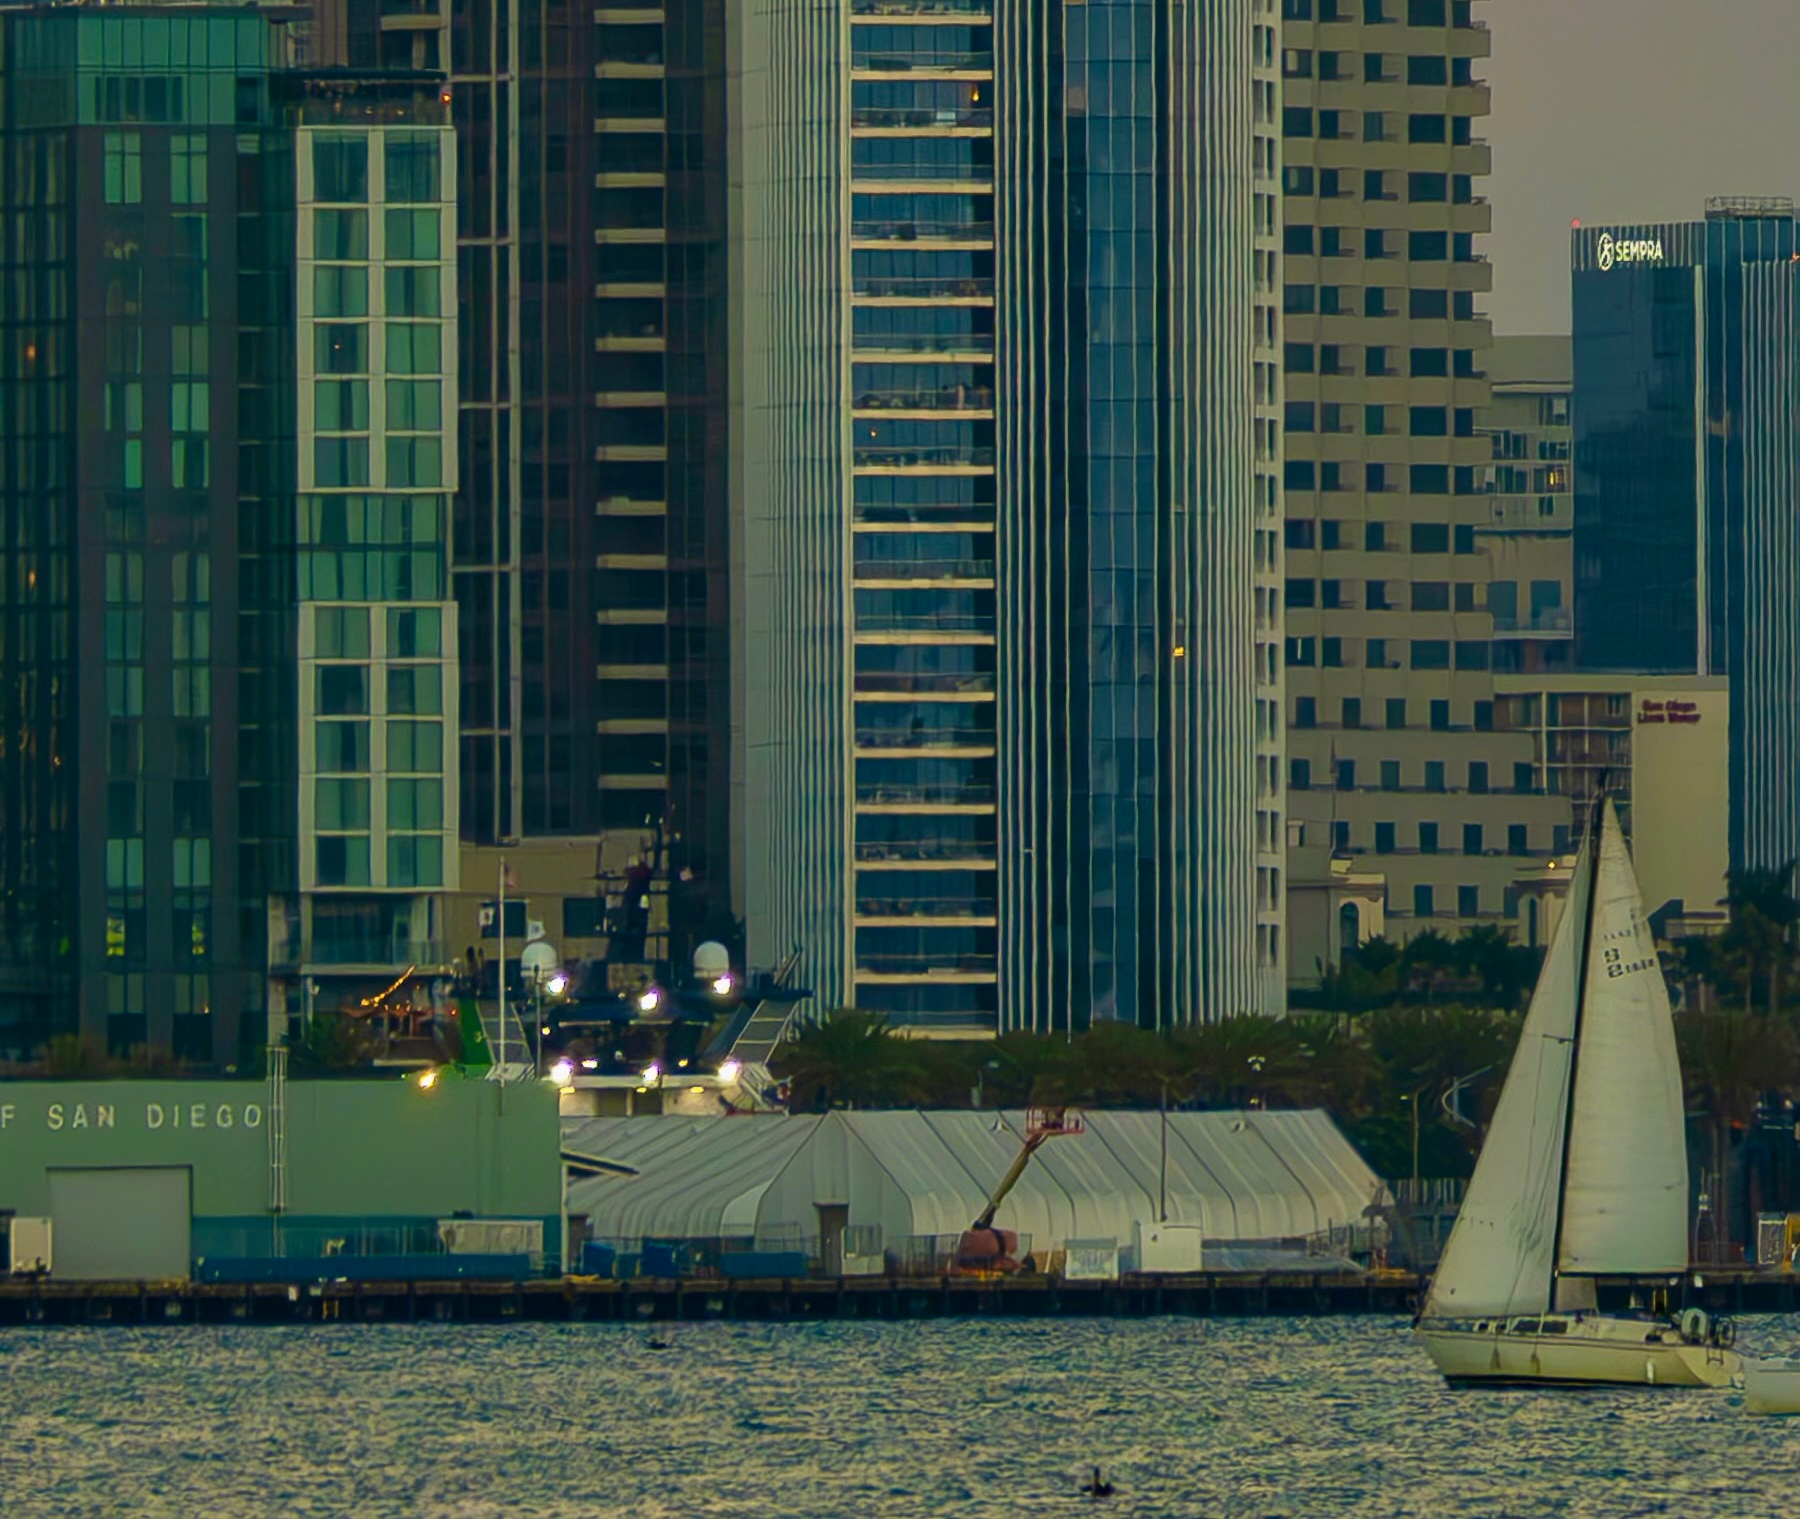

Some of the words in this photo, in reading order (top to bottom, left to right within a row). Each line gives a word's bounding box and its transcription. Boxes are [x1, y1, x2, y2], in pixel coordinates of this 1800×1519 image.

[1615, 239, 1664, 262] SEMPRA
[47, 1104, 115, 1130] SAN
[147, 1103, 262, 1129] DIEGO
